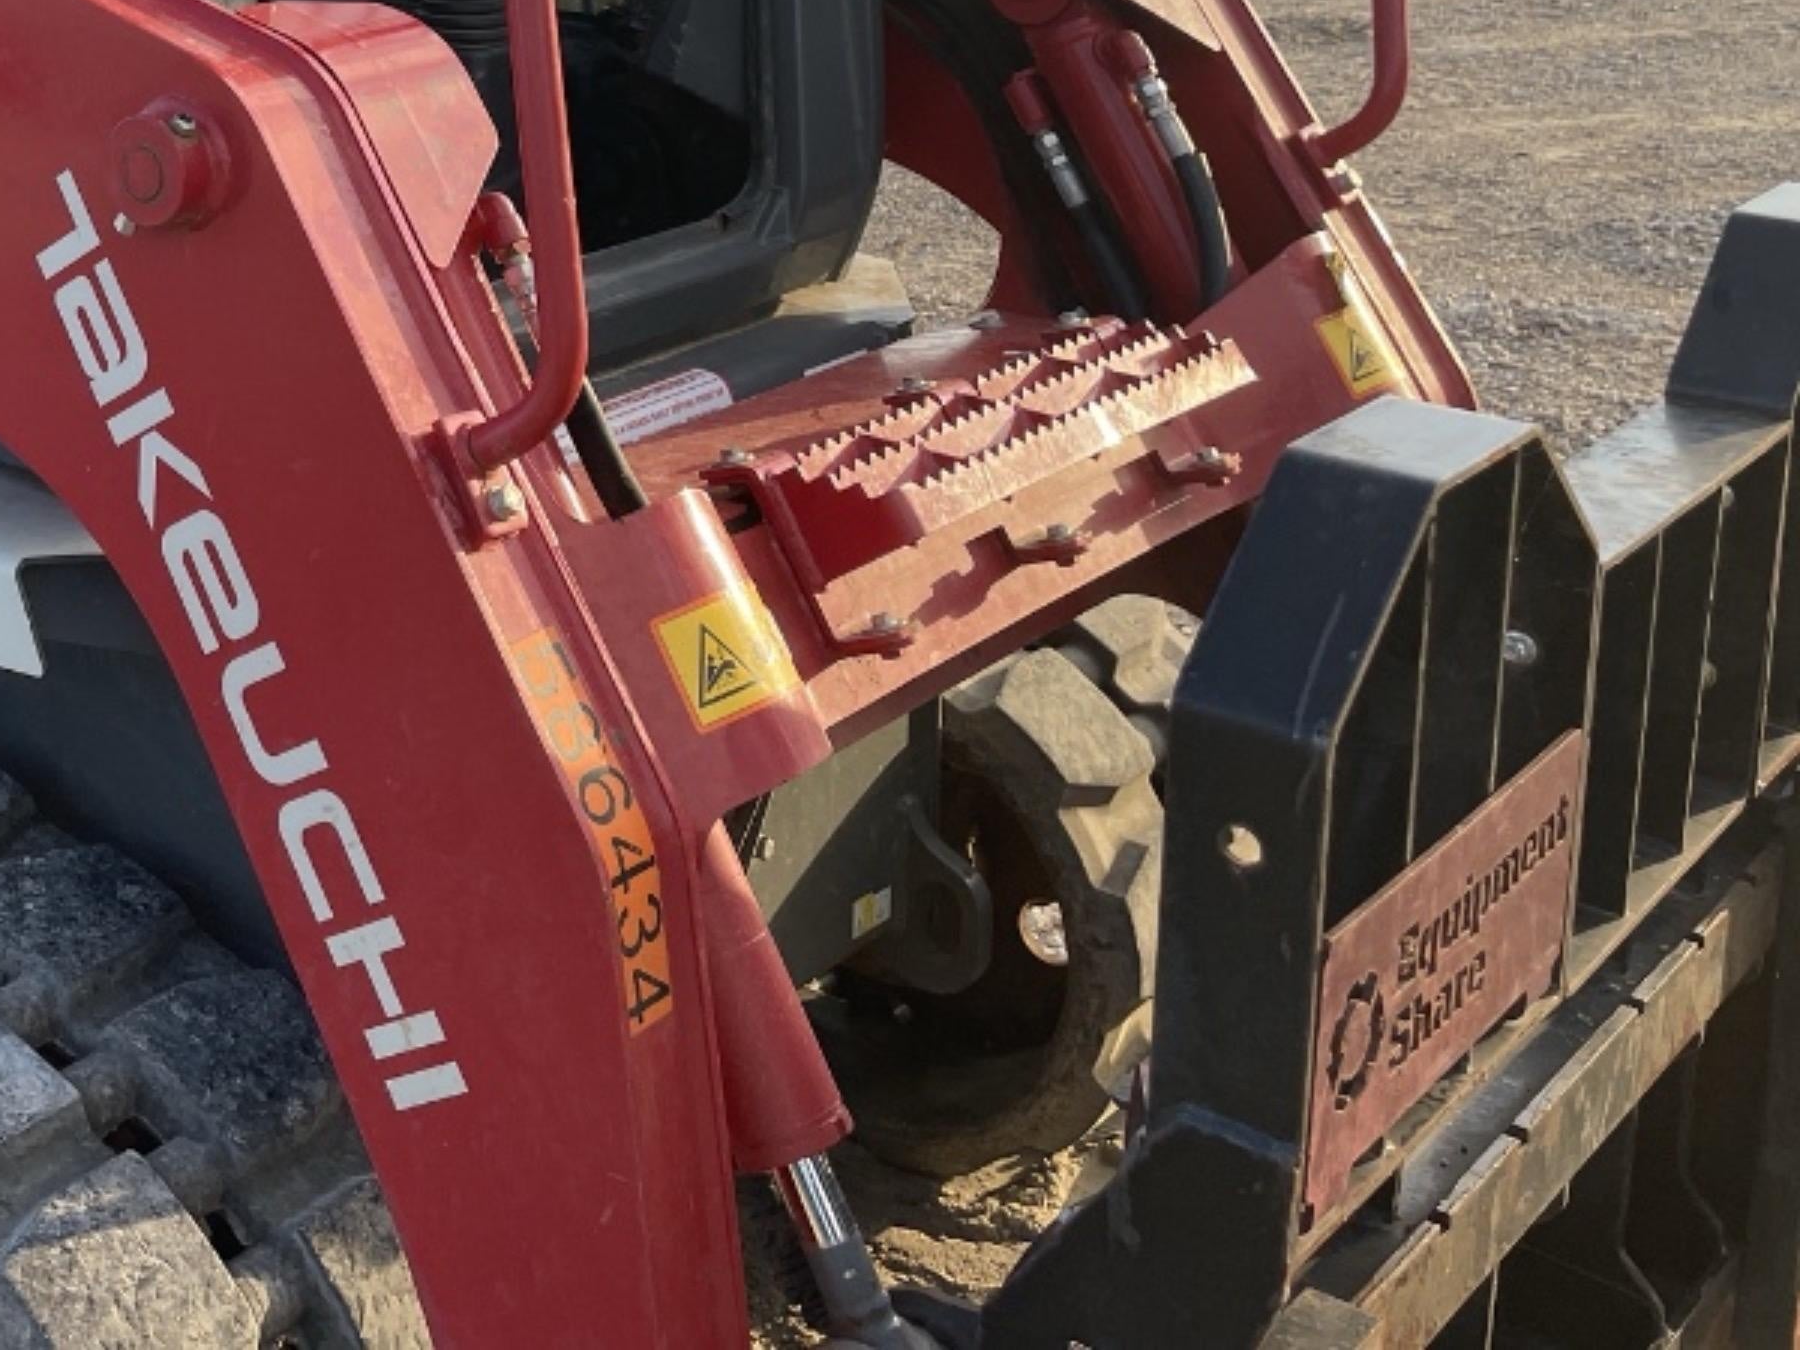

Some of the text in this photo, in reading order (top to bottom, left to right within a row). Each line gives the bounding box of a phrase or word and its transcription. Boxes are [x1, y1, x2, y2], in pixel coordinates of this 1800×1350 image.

[36, 169, 468, 1113] TAKEUCHI
[1396, 793, 1570, 982] Equipment
[1388, 949, 1488, 1068] Share
